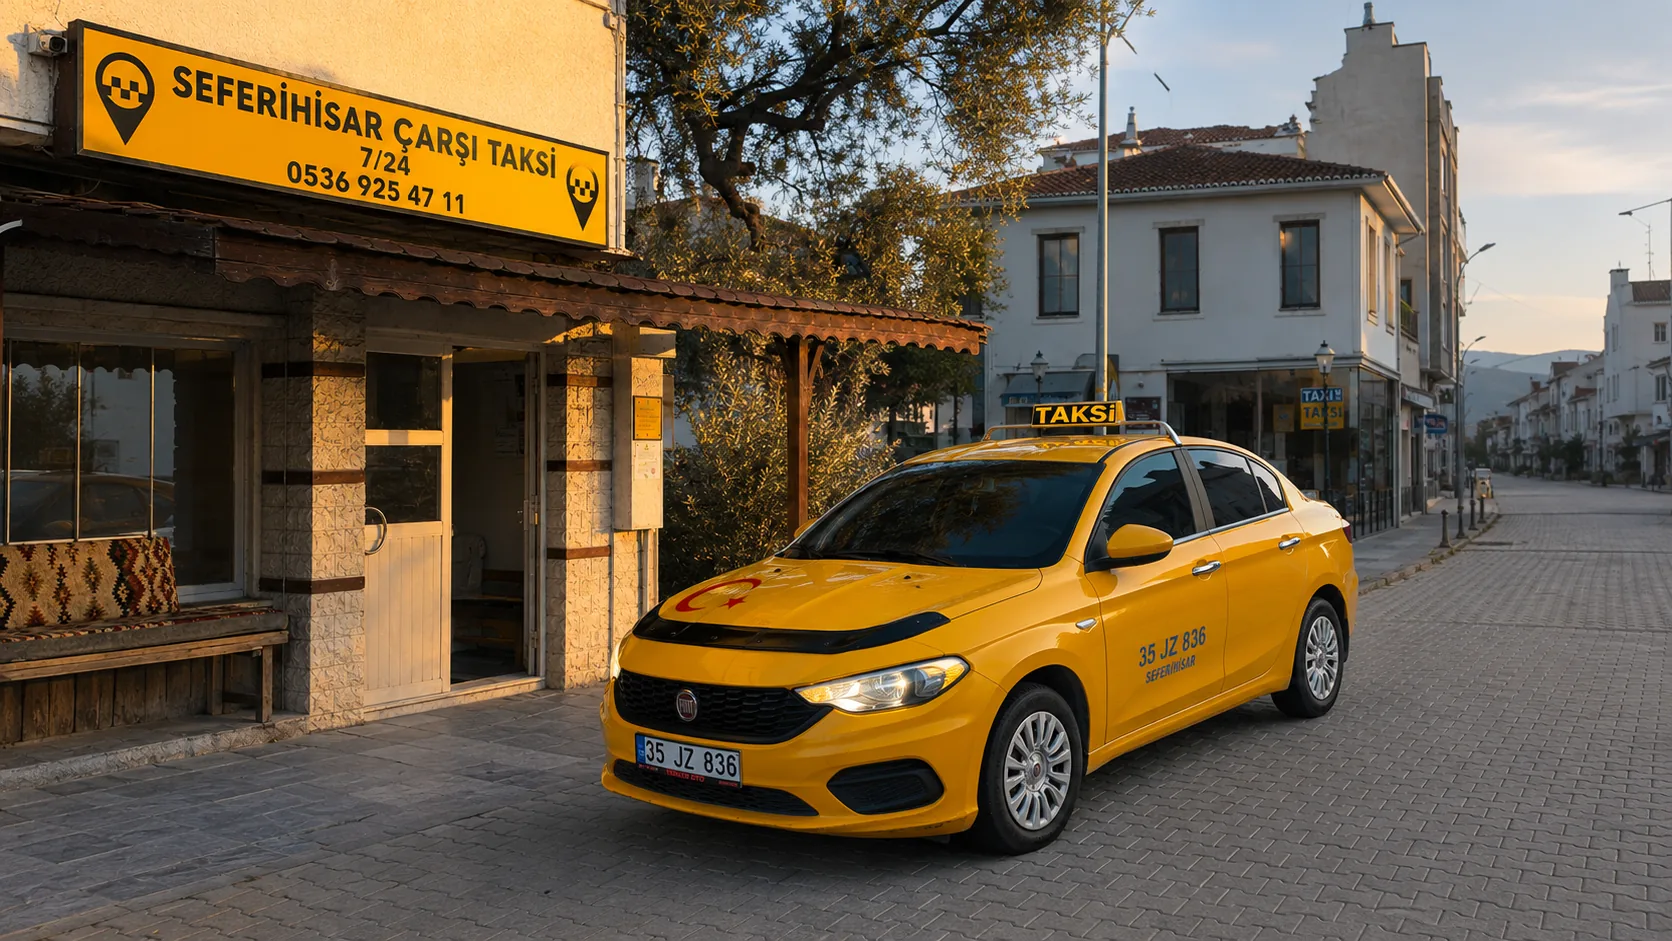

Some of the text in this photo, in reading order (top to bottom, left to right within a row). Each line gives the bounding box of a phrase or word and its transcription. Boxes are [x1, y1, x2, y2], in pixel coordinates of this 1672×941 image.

[172, 65, 556, 179] SEFERİHİSAR ÇARŞI TAKSİ
[360, 146, 411, 176] 7/24
[287, 161, 464, 214] 0536 925 47 11
[1139, 626, 1206, 667] 35 JZ 836
[645, 740, 665, 764] 35
[674, 746, 695, 770] JZ
[703, 751, 738, 778] 836
